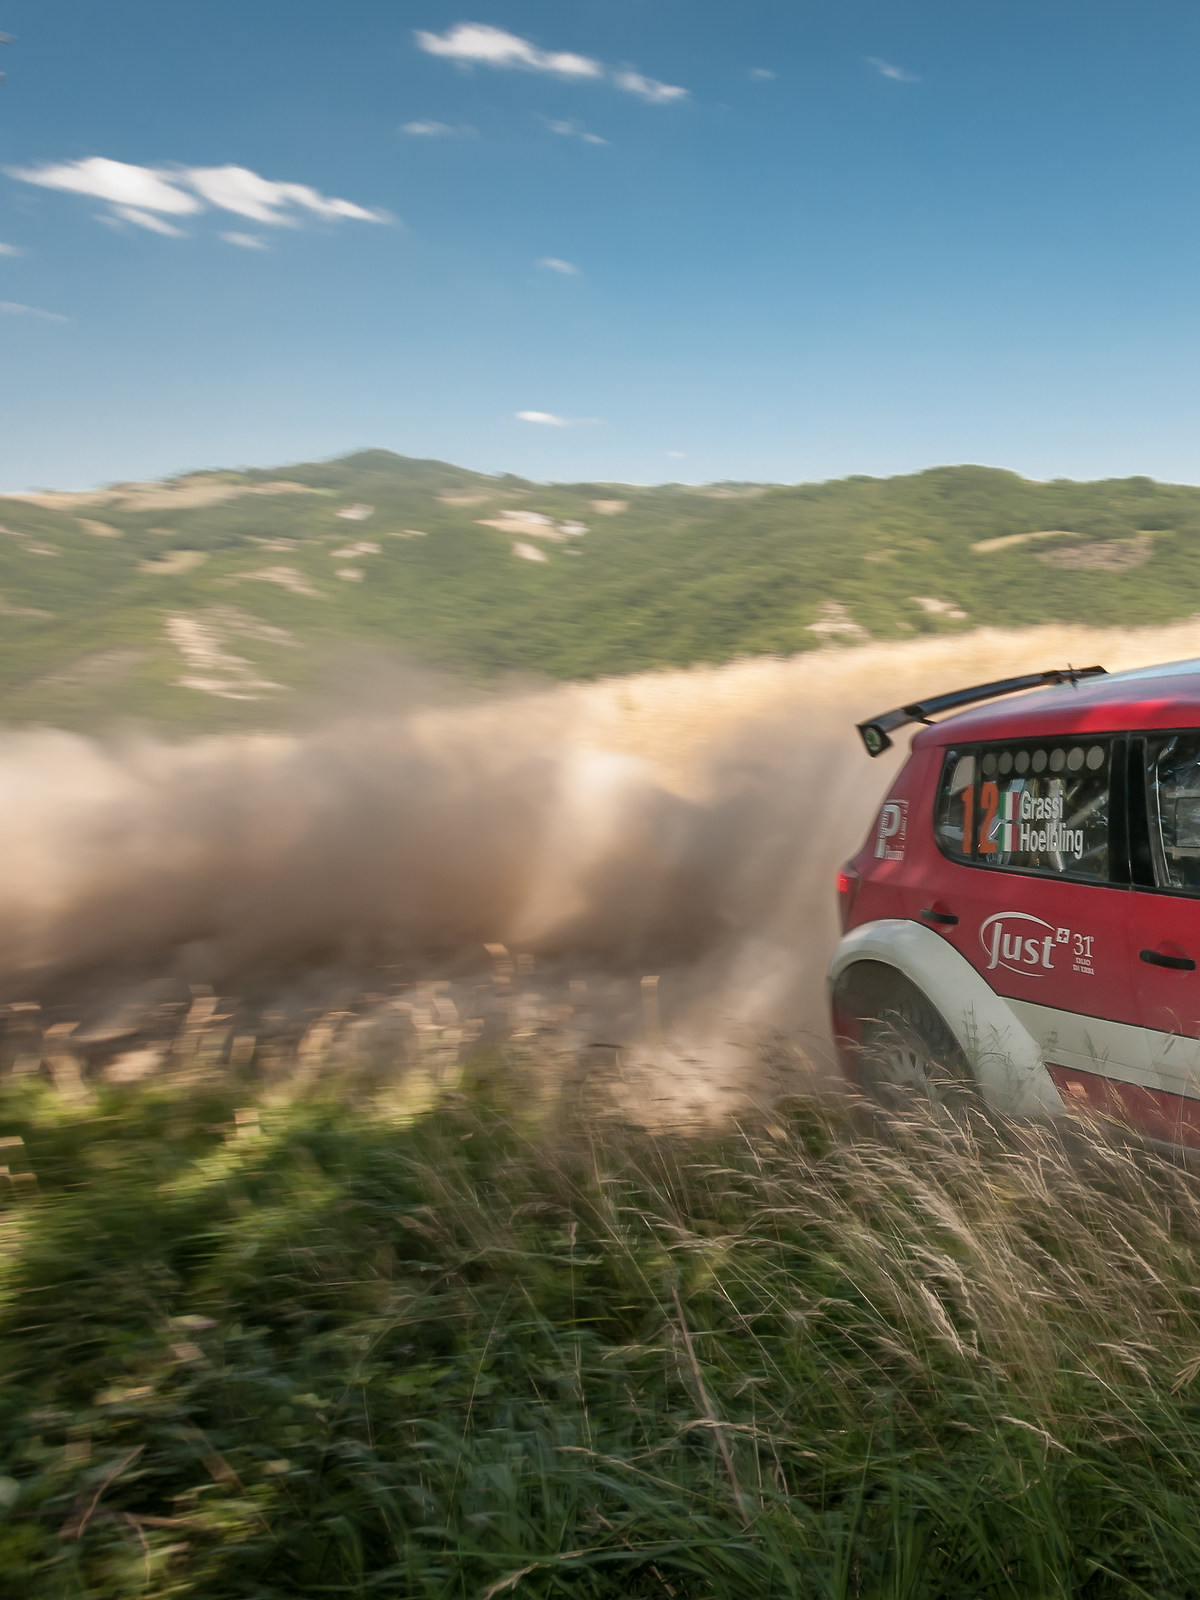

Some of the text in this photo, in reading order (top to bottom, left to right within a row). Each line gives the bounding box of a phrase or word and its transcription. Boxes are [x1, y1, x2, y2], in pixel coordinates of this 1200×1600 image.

[962, 781, 998, 854] 12
[1021, 789, 1063, 820] Grassi
[1020, 822, 1083, 859] Hoelbling
[986, 922, 1056, 970] Just
